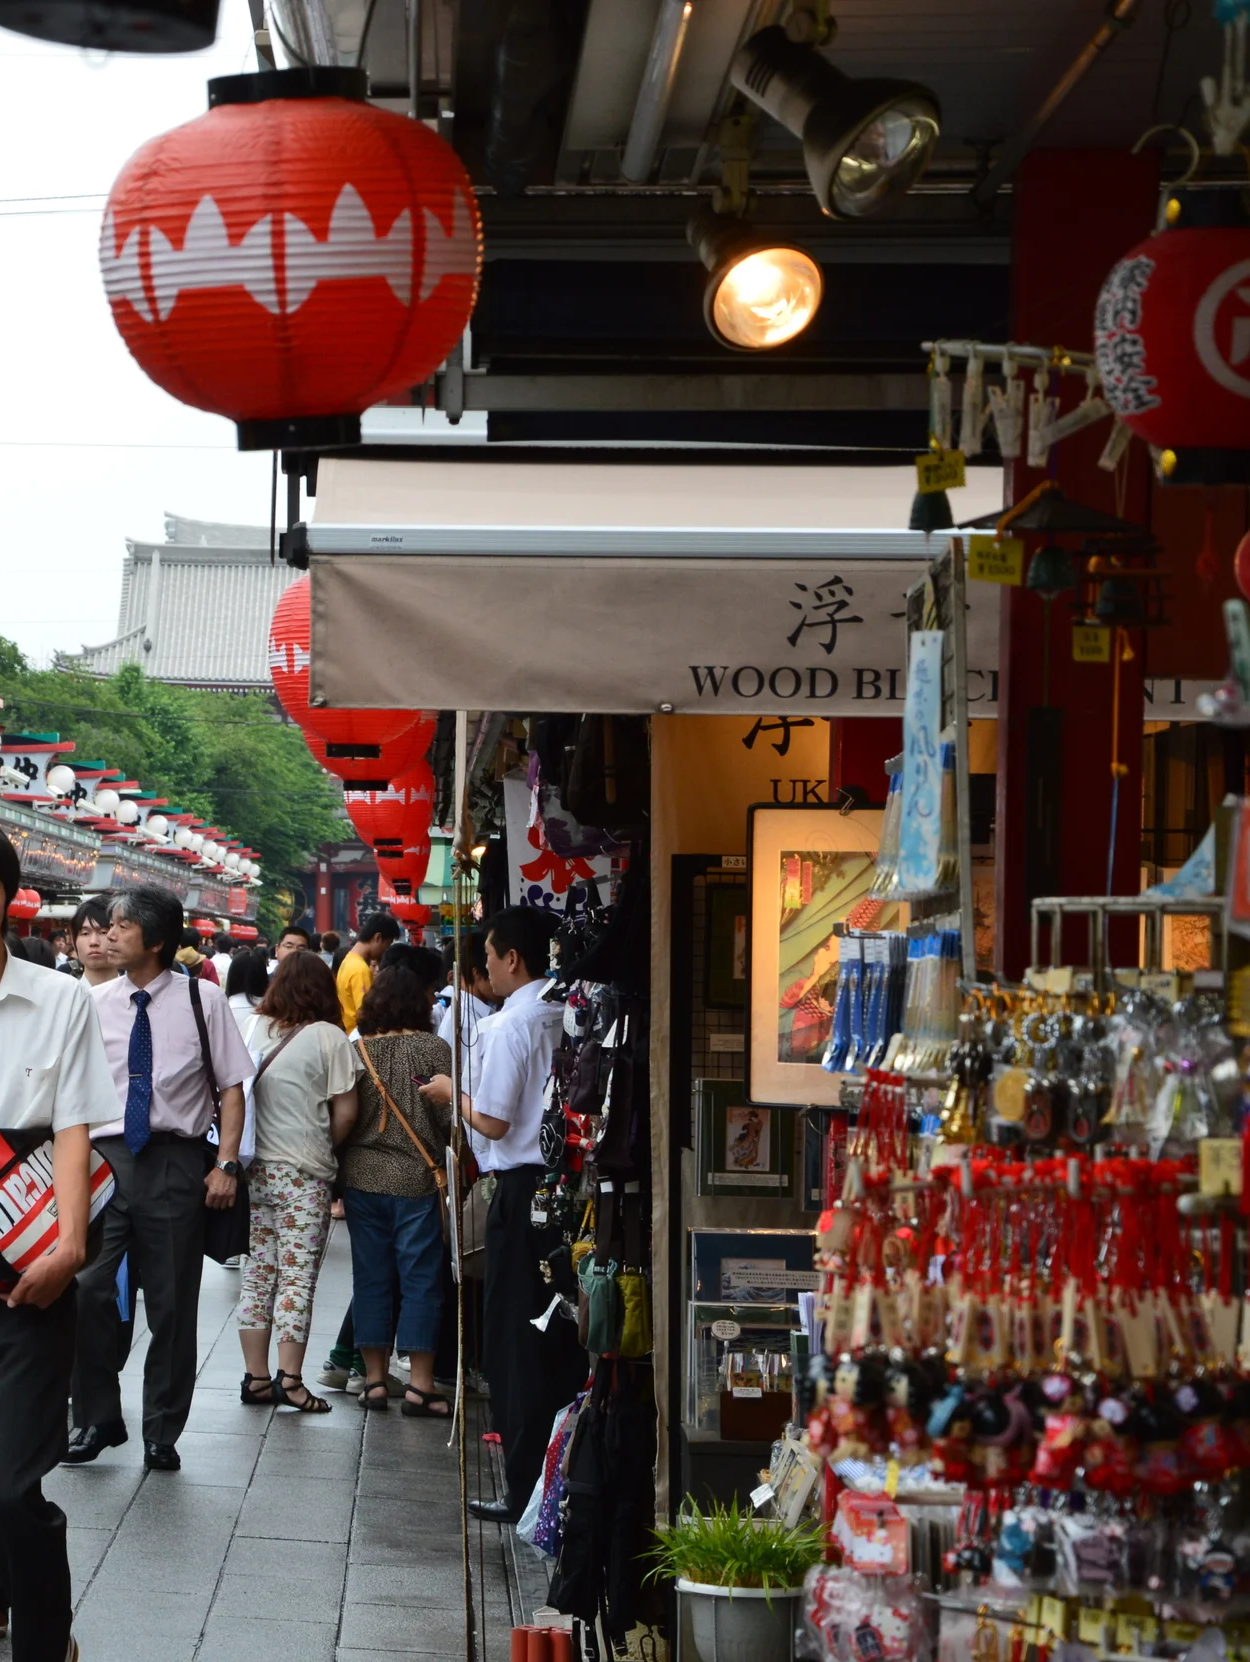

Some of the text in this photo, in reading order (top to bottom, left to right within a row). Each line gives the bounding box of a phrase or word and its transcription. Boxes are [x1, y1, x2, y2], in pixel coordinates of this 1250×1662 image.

[688, 665, 999, 703] WOOD BLC
[25, 1067, 32, 1078] T
